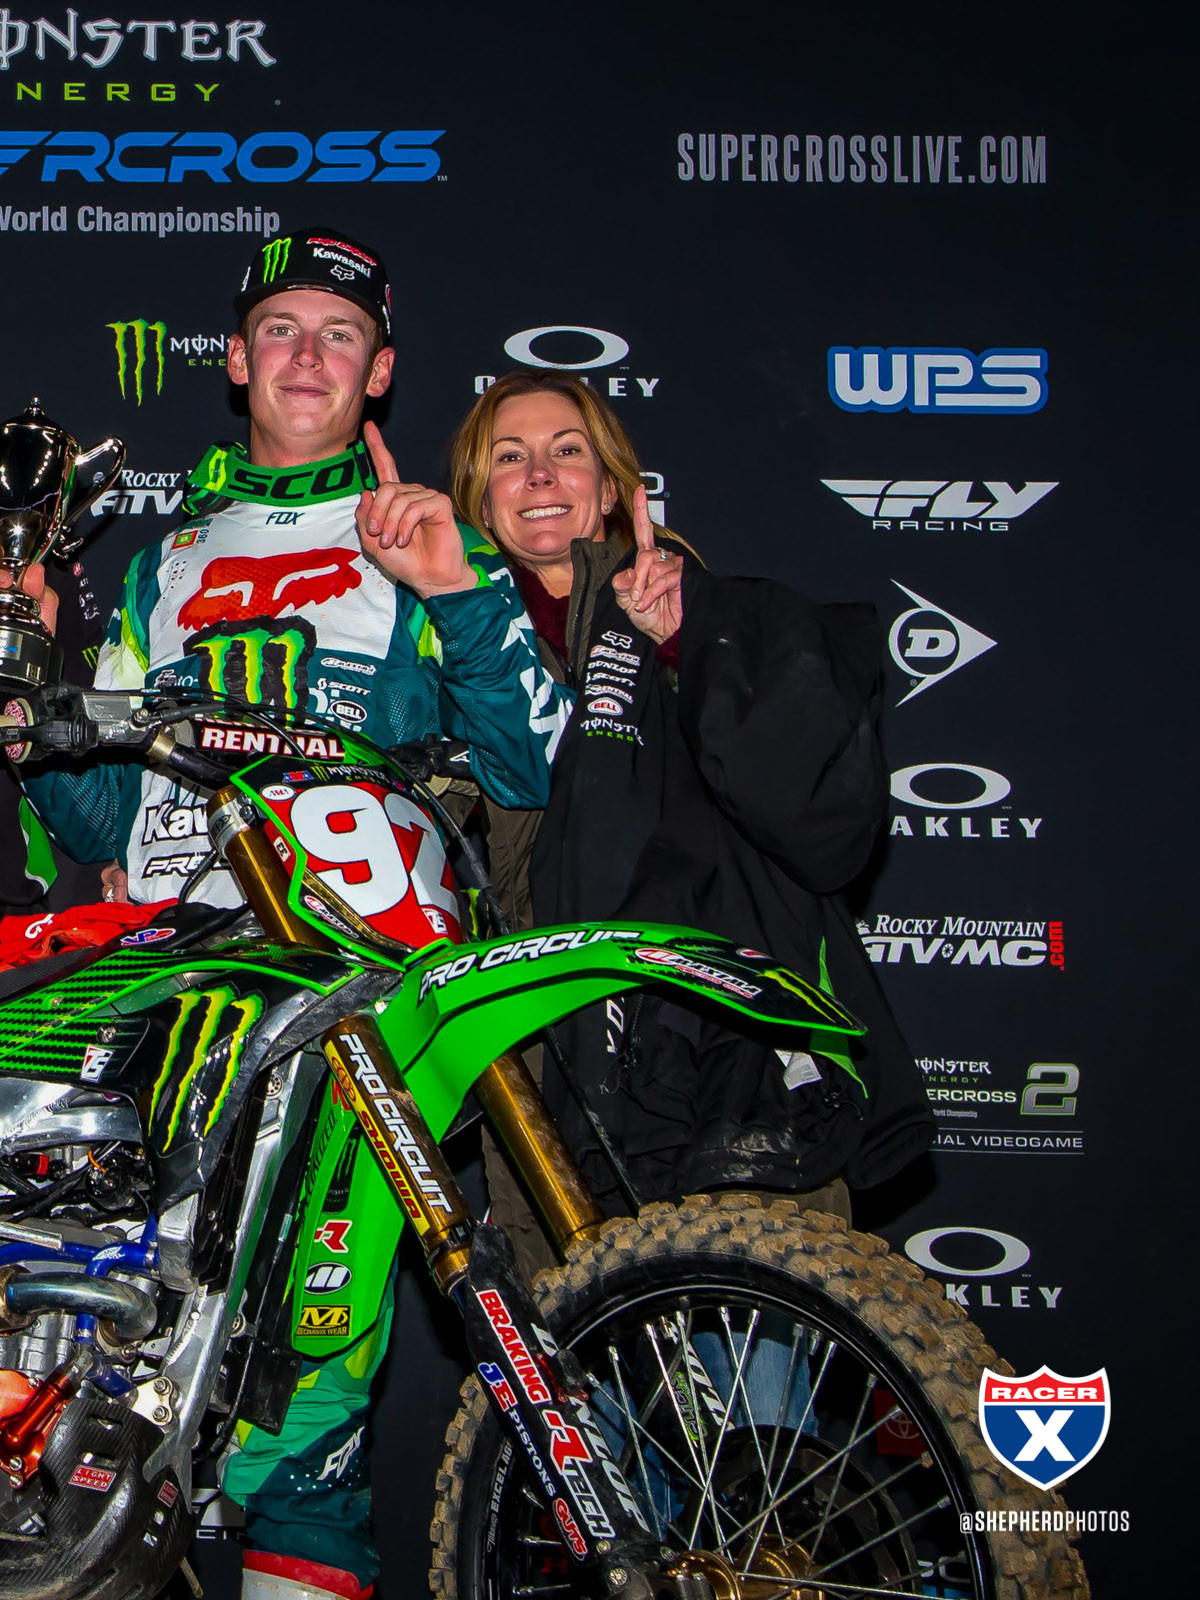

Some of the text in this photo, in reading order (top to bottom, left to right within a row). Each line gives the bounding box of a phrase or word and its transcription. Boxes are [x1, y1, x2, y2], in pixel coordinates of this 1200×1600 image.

[677, 133, 1047, 184] SUPERCROSSLIVE.COM
[76, 206, 281, 240] Championship
[313, 247, 371, 279] Kawasaki
[832, 352, 1042, 408] WPS
[122, 469, 181, 488] ROCKY
[820, 479, 1060, 520] FLY
[265, 512, 306, 527] FOX
[872, 521, 1009, 532] RACING
[588, 660, 637, 674] DUNLOP
[328, 681, 371, 696] SCOTT
[336, 704, 362, 719] BELL
[594, 703, 617, 712] BELL
[889, 816, 1043, 838] AKLEY
[290, 784, 461, 924] 92
[874, 914, 1047, 938] ROCKY MOUNTAIN
[480, 931, 642, 971] CIRCUIT
[1049, 921, 1065, 971] .com
[922, 1076, 980, 1084] NERGY
[1020, 1062, 1081, 1116] 2
[926, 1089, 1017, 1103] ERCROSS
[339, 1034, 453, 1213] PRO CIRCUIT
[971, 1136, 1083, 1149] VIDEOGAME
[358, 1111, 422, 1218] SHOWA
[946, 1283, 1062, 1309] KLEY
[479, 1290, 551, 1403] BRAKING
[510, 1408, 556, 1497] PISTONS
[72, 1476, 108, 1488] SPEED
[77, 1469, 113, 1482] LIGHT
[555, 1497, 586, 1555] GUTS
